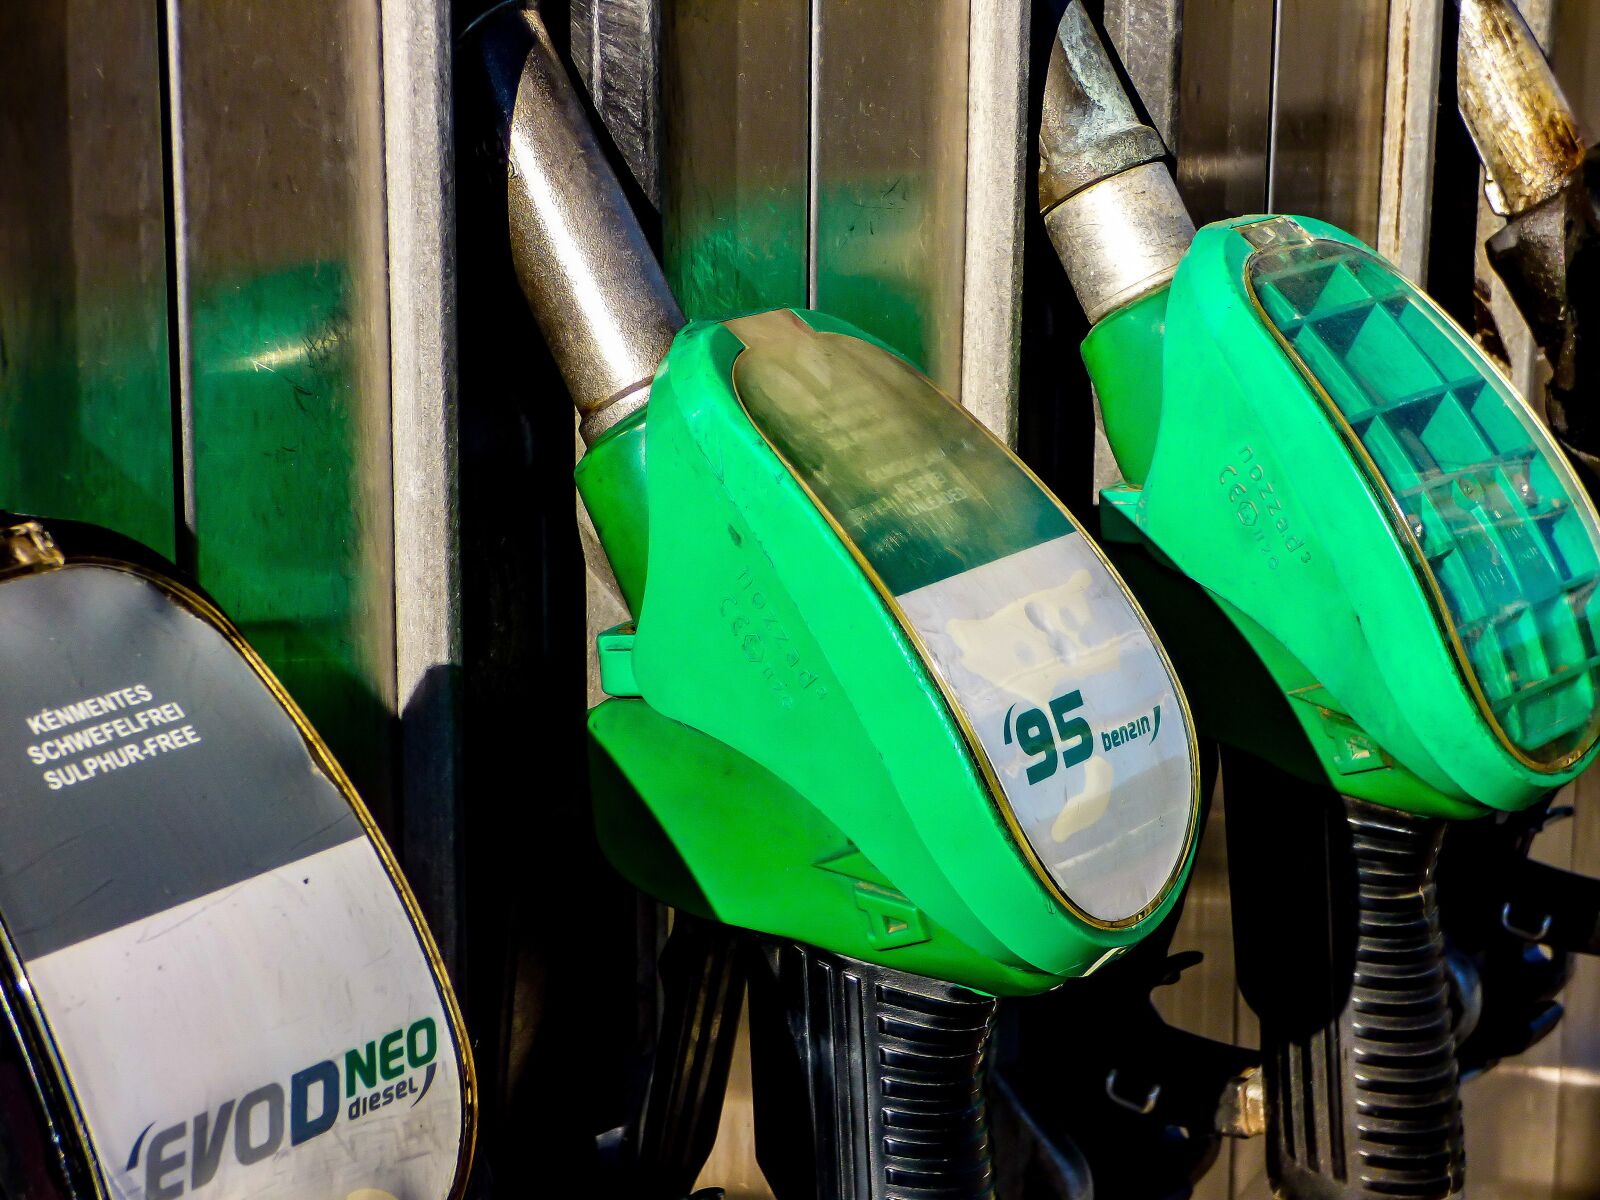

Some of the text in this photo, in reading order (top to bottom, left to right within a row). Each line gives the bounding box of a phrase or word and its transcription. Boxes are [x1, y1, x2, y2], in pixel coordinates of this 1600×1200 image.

[26, 684, 153, 735] KÉNMENTES
[27, 702, 186, 765] SCHWEFELFREI
[1015, 689, 1151, 786] 95 benzin
[43, 725, 202, 790] SULPHUR-FREE
[345, 1017, 438, 1099] NEO
[348, 1075, 419, 1121] diesel
